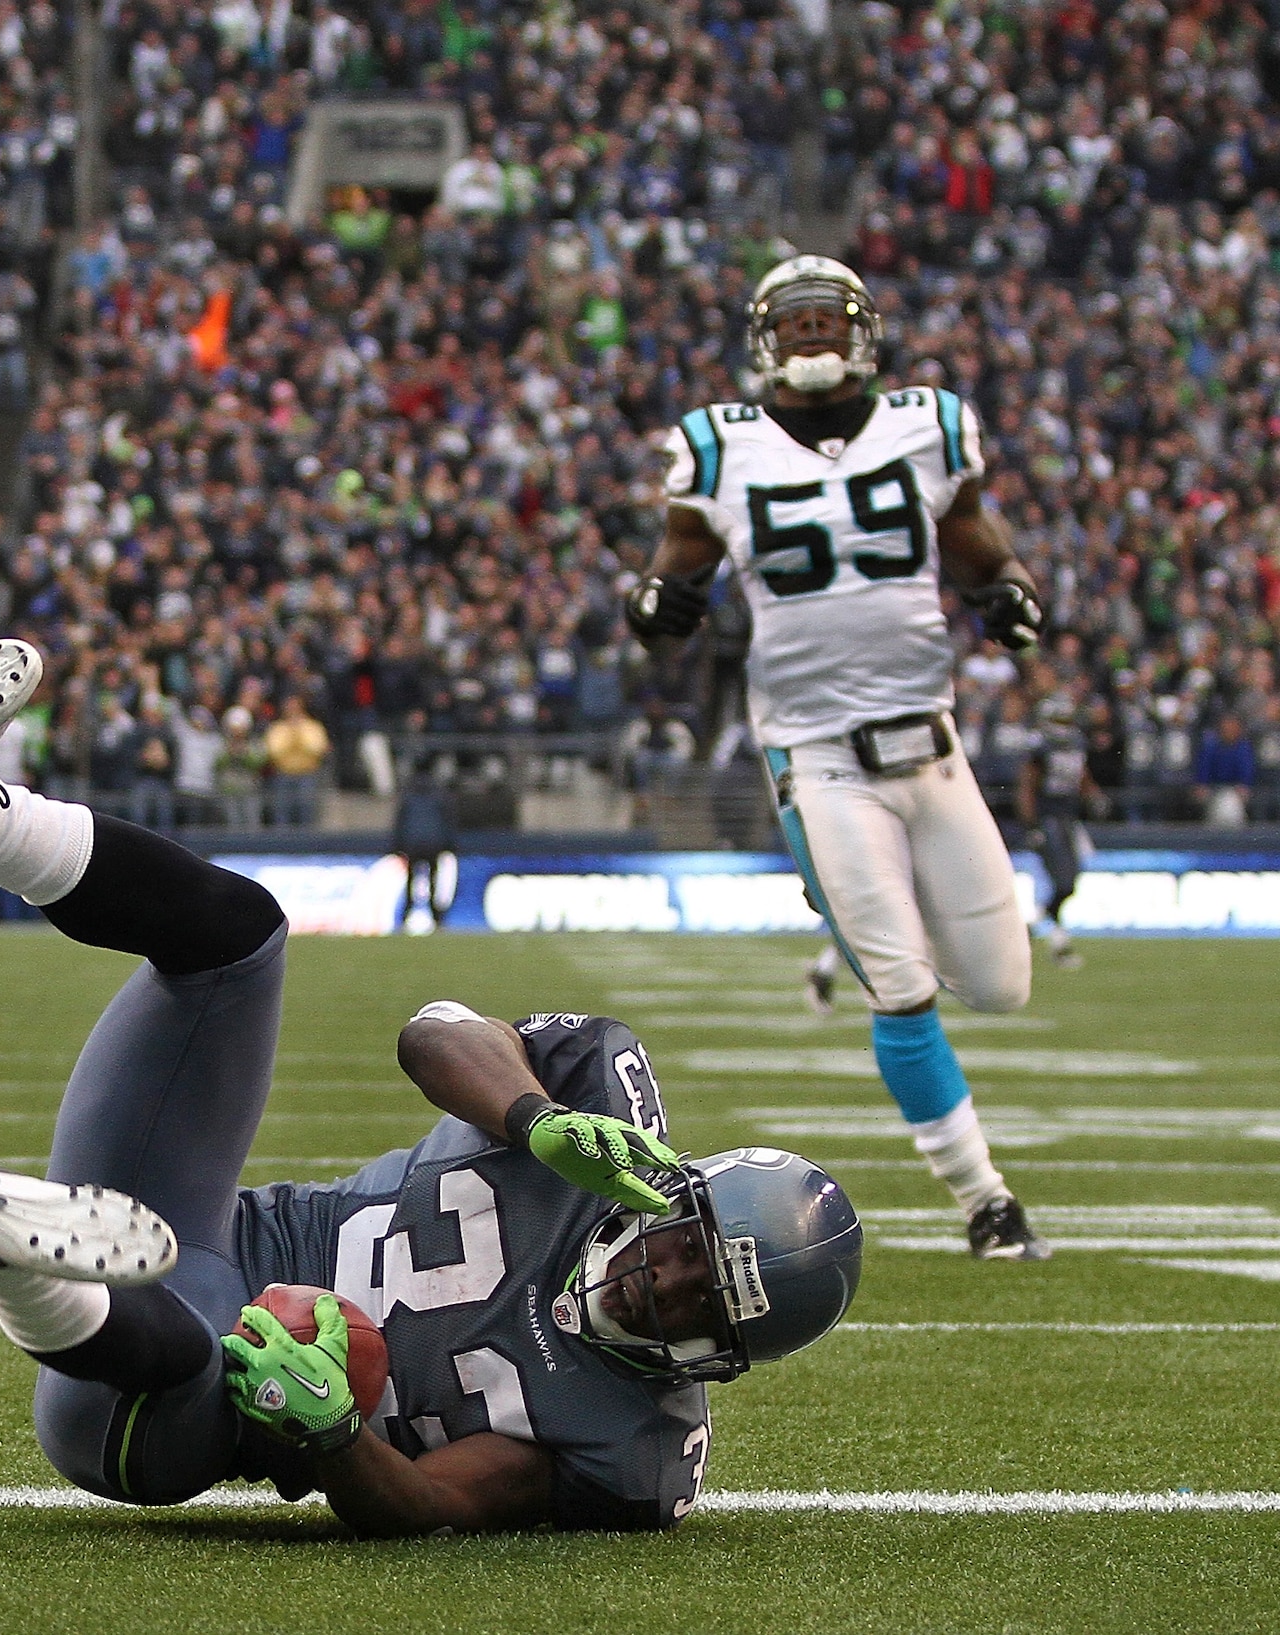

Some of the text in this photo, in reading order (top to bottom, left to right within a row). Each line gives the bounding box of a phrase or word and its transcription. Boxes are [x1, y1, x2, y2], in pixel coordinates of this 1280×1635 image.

[747, 459, 928, 597] 59
[742, 1256, 760, 1299] Riddell
[526, 1283, 557, 1373] SEAHAWKS
